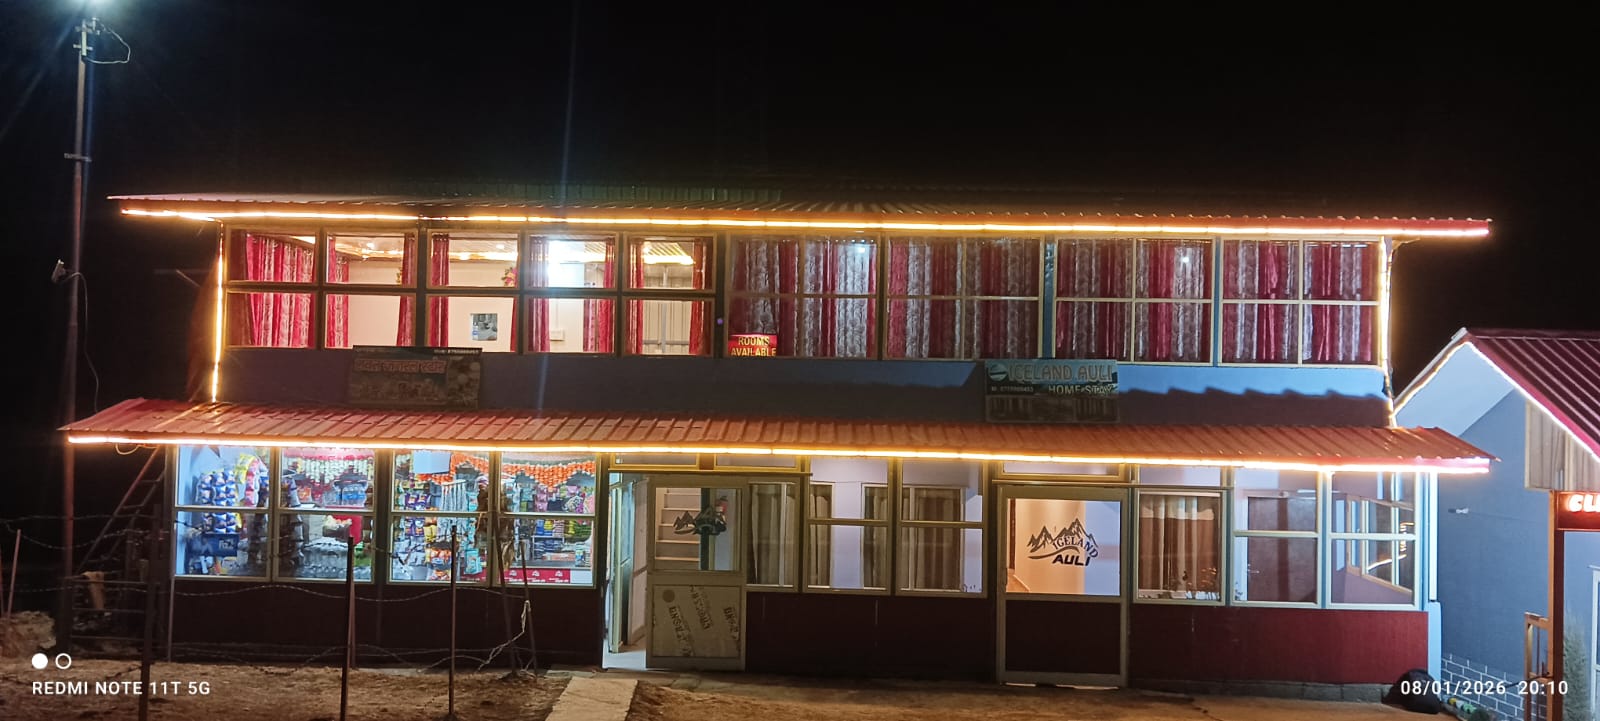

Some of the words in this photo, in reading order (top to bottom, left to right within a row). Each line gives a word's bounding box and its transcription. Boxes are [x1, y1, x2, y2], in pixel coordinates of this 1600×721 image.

[738, 336, 770, 346] ROOMS
[730, 347, 777, 357] AVAILABLE
[1008, 363, 1073, 382] ICELAND
[1077, 364, 1113, 382] AULI
[1048, 384, 1081, 396] HOME
[1052, 554, 1091, 567] AULI
